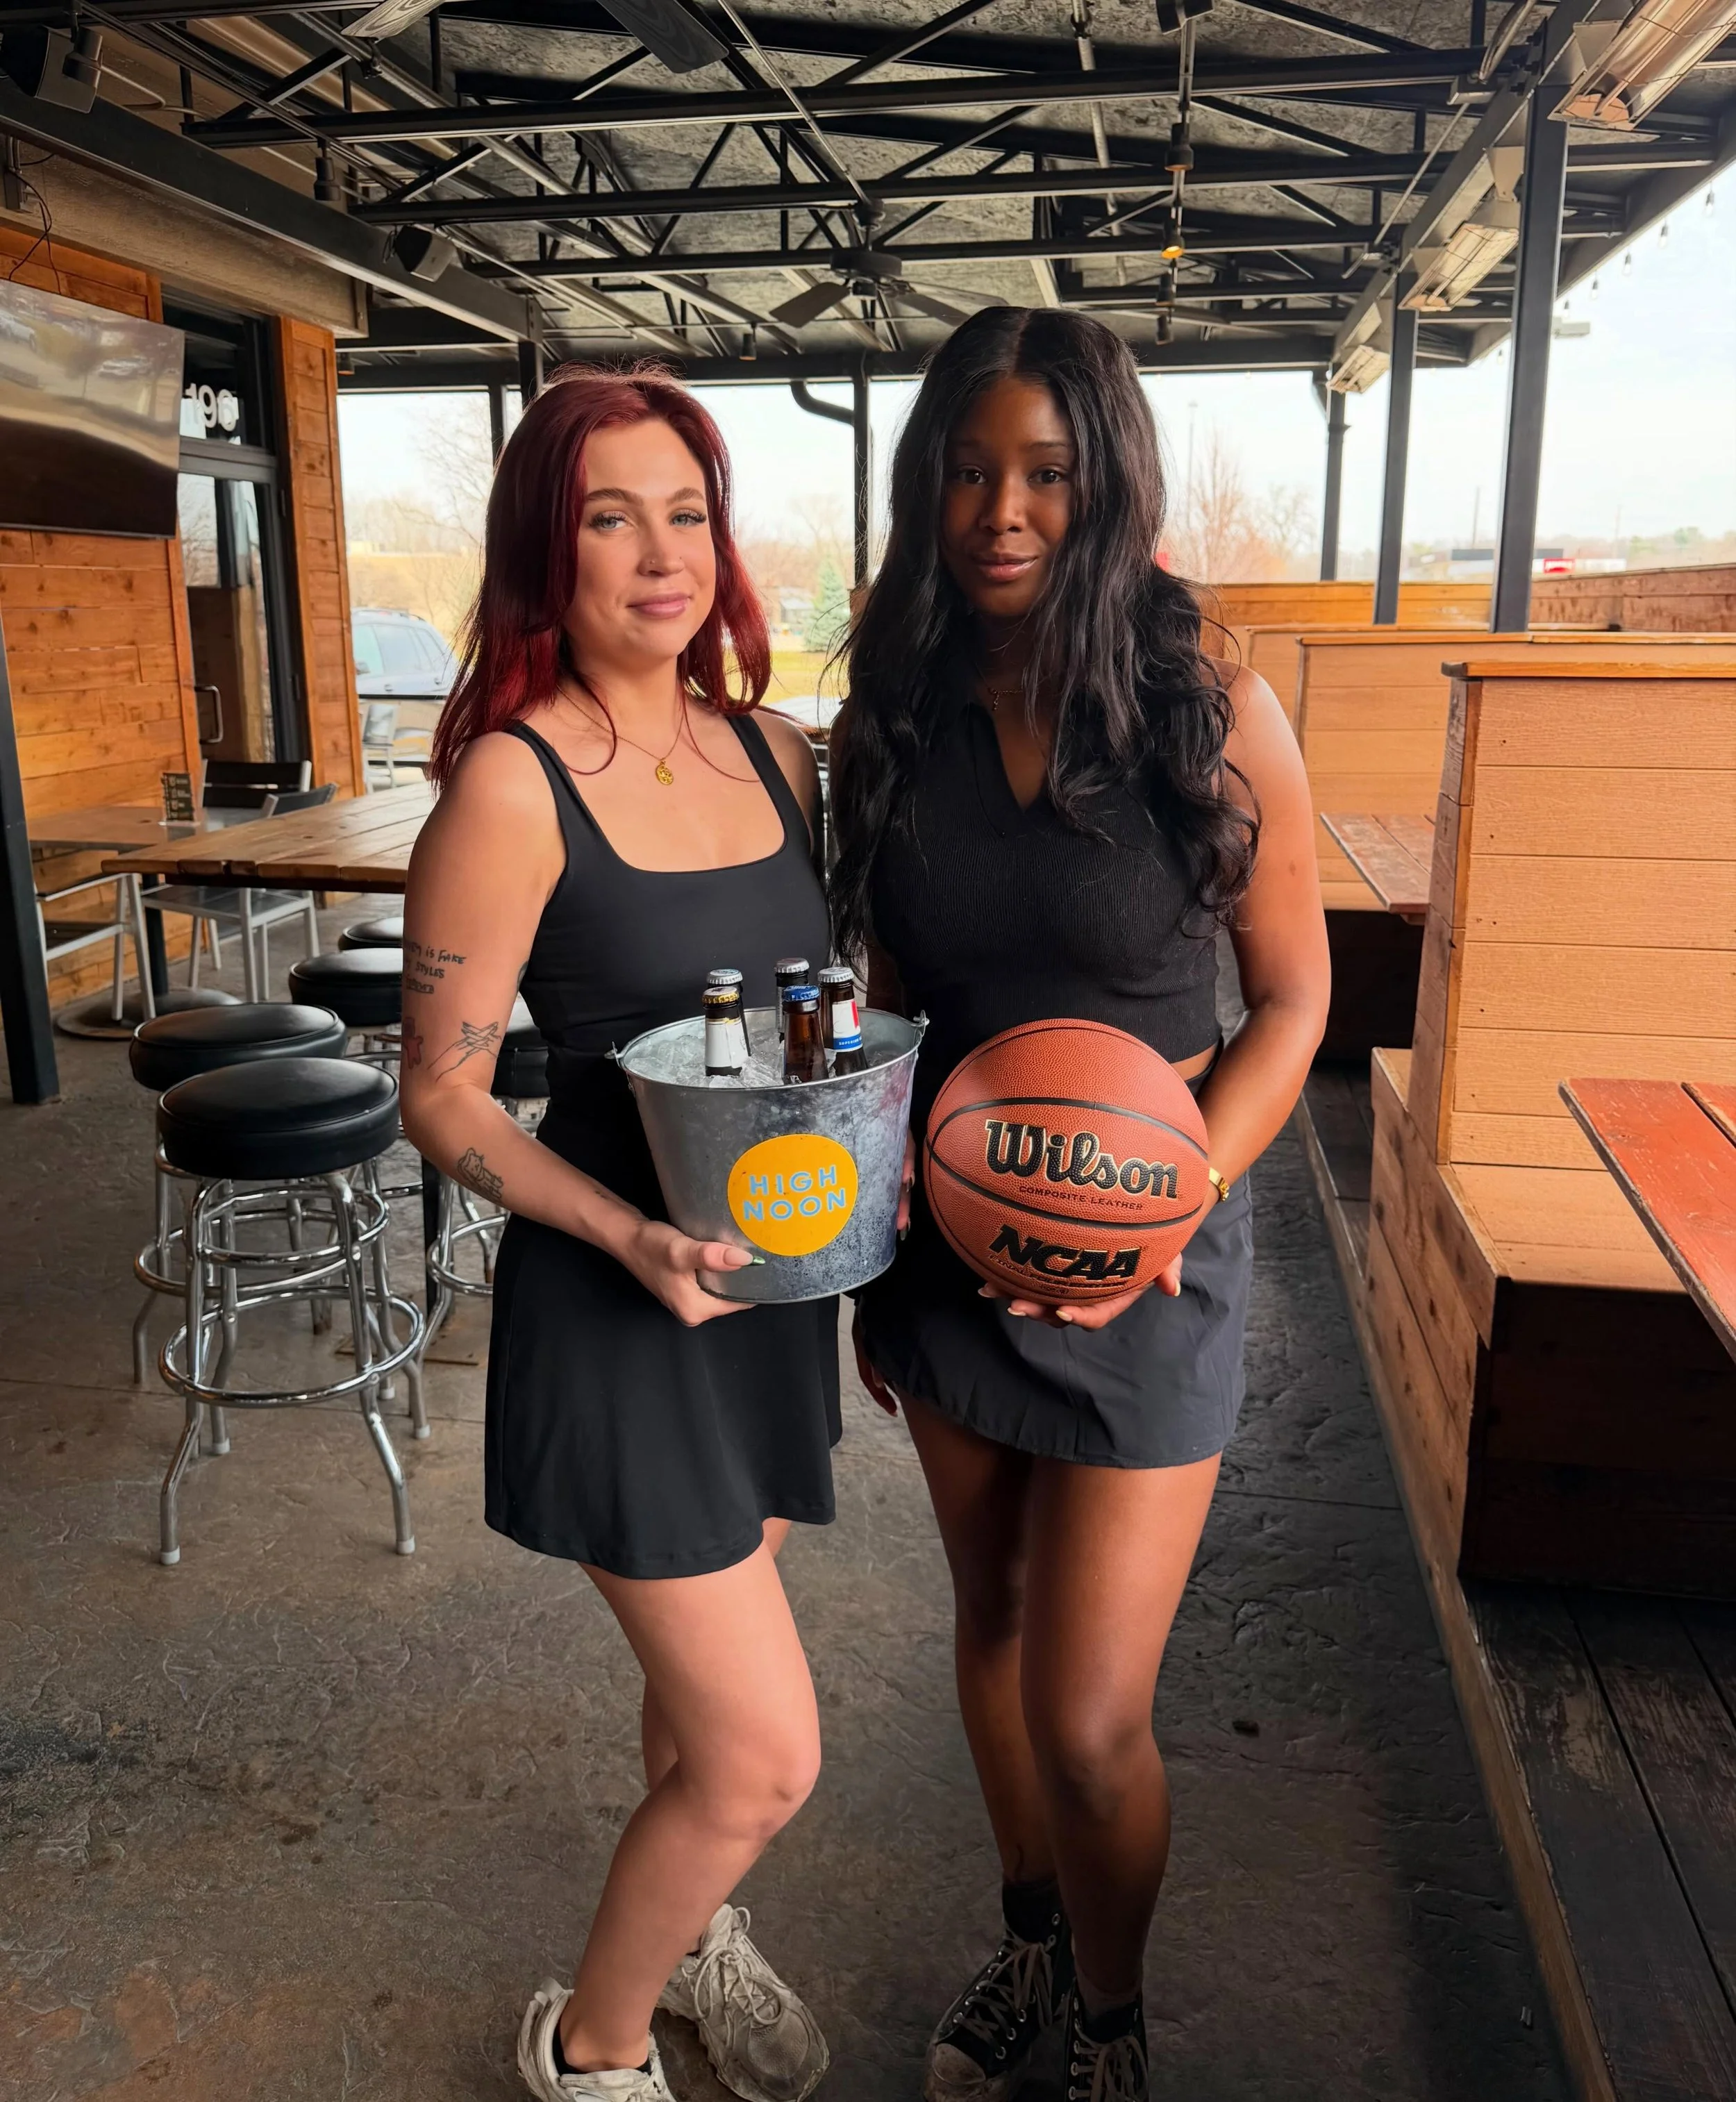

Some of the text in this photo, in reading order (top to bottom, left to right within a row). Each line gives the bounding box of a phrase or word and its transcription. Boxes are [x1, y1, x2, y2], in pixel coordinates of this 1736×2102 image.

[416, 962, 445, 978] STYLES
[985, 1119, 1178, 1199] Wilson
[749, 1165, 837, 1196] HIGH
[742, 1188, 846, 1221] NOON
[1019, 1185, 1144, 1210] COMPOSITE LEATHER
[988, 1224, 1142, 1281] NCAA
[989, 1254, 1026, 1276] FINAL
